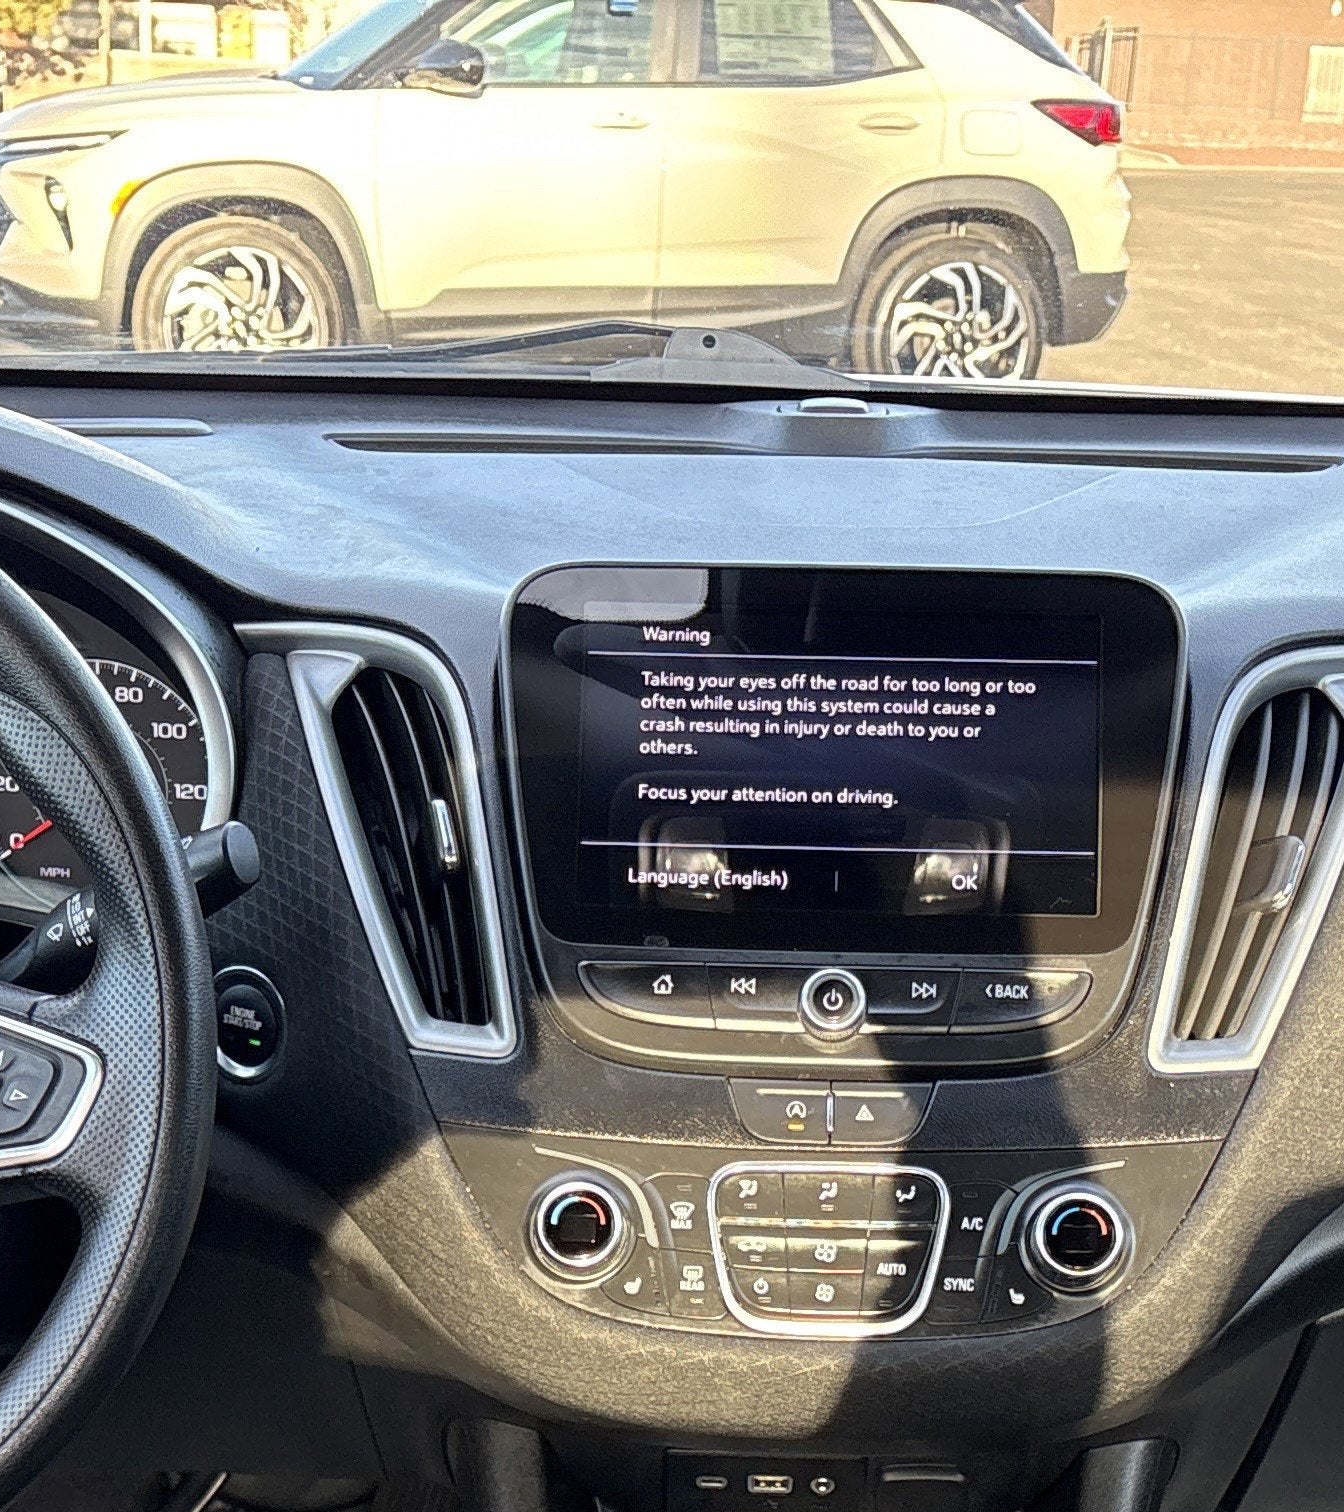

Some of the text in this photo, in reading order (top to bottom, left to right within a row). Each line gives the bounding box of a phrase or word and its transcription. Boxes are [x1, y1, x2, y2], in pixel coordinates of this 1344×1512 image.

[642, 626, 711, 647] Warning
[641, 671, 1036, 697] Taking your eyes off the road for too long or too
[114, 686, 144, 703] 80
[640, 693, 996, 717] often while using this system could cause a
[151, 722, 187, 739] 100
[639, 716, 982, 742] crash resulting in injury or death to you or
[639, 738, 698, 755] others.
[173, 783, 207, 801] 120
[638, 784, 899, 809] Focus your attention on driving.
[39, 866, 71, 879] MPH
[628, 868, 789, 890] Language (English)
[951, 874, 978, 891] OK
[994, 983, 1030, 1000] BACK
[960, 1216, 984, 1232] A/C
[876, 1262, 907, 1277] AUTO
[942, 1277, 975, 1293] SYNC
